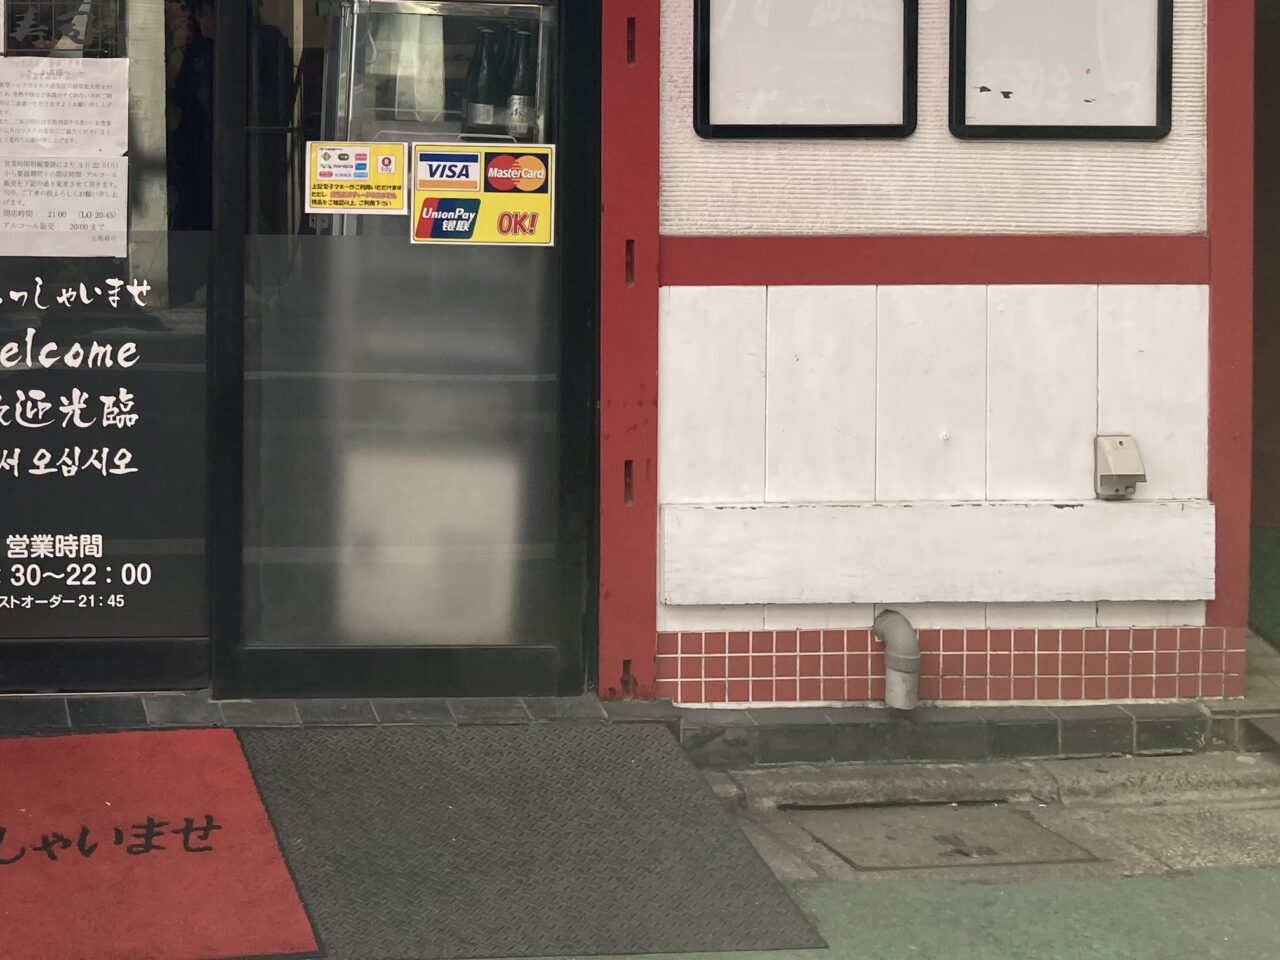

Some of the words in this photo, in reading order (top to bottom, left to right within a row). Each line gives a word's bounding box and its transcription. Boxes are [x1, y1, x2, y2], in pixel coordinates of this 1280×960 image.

[427, 163, 471, 179] VISA
[487, 166, 547, 180] MasterCard
[422, 206, 476, 225] UnionPay
[496, 210, 539, 236] OK!
[28, 446, 139, 477] 오십시오
[6, 534, 103, 558] 営業時間
